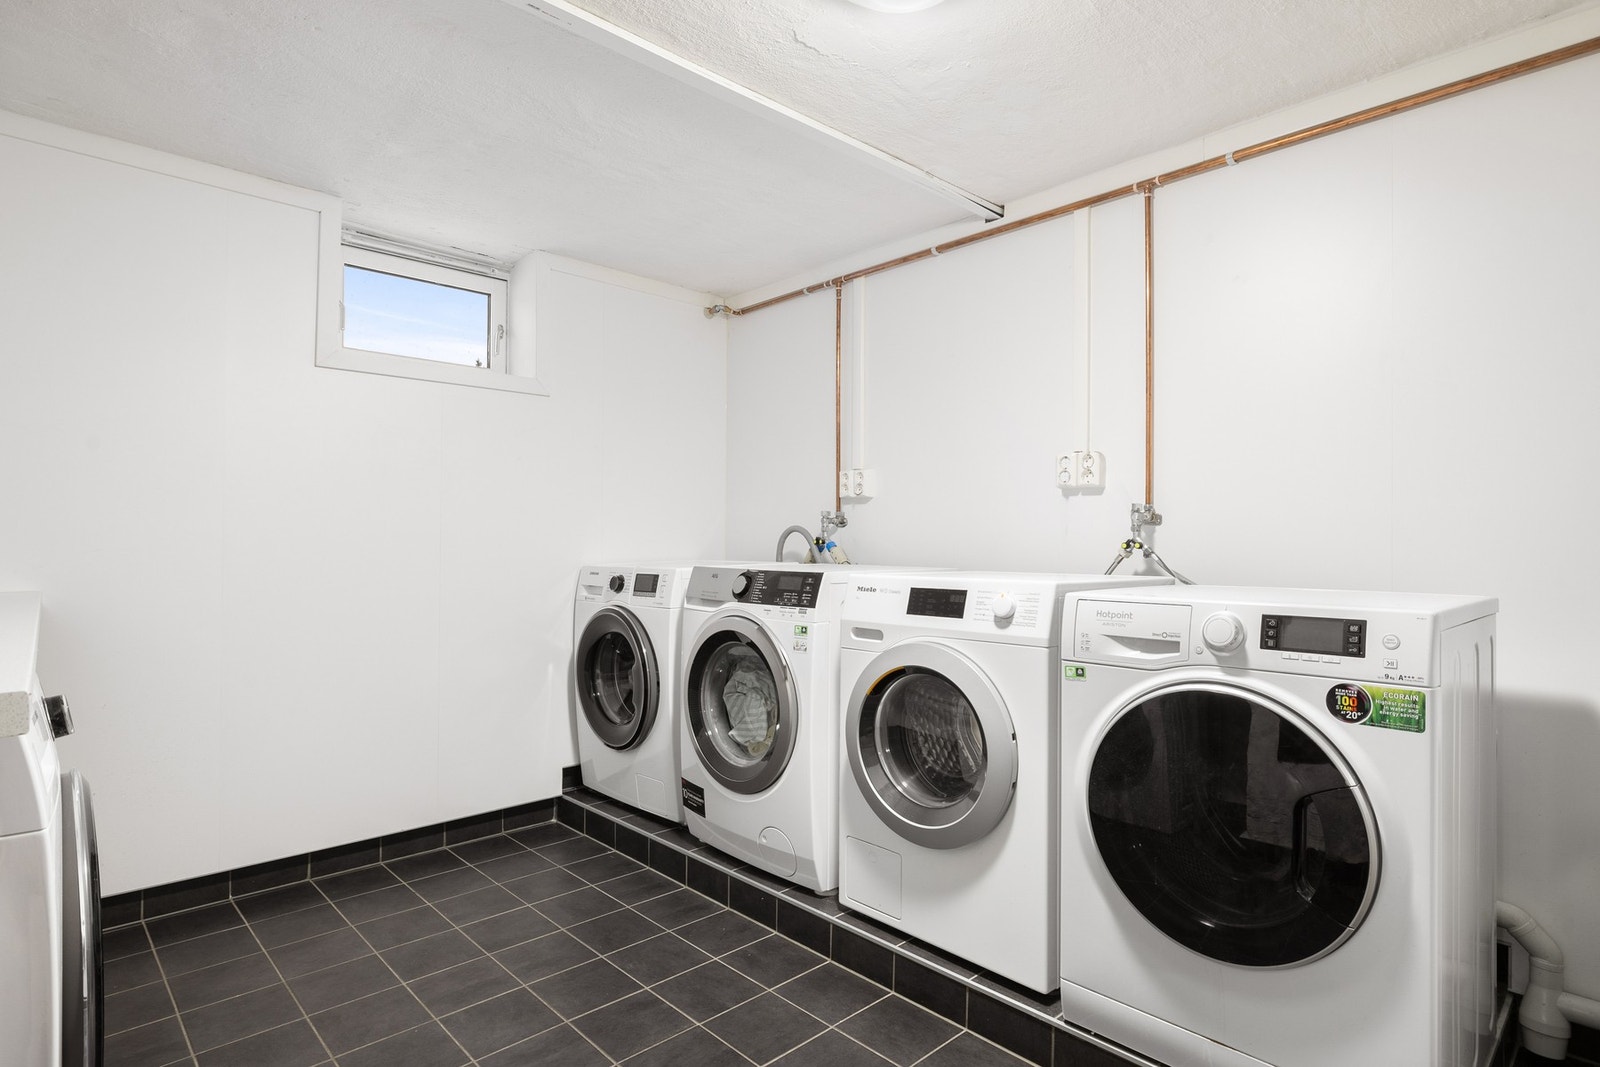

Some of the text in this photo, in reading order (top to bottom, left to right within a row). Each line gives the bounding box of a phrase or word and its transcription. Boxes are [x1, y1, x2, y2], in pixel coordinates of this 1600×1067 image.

[1096, 610, 1133, 620] Hotpoint
[1336, 696, 1357, 706] 100
[1384, 692, 1419, 702] ECORAIN
